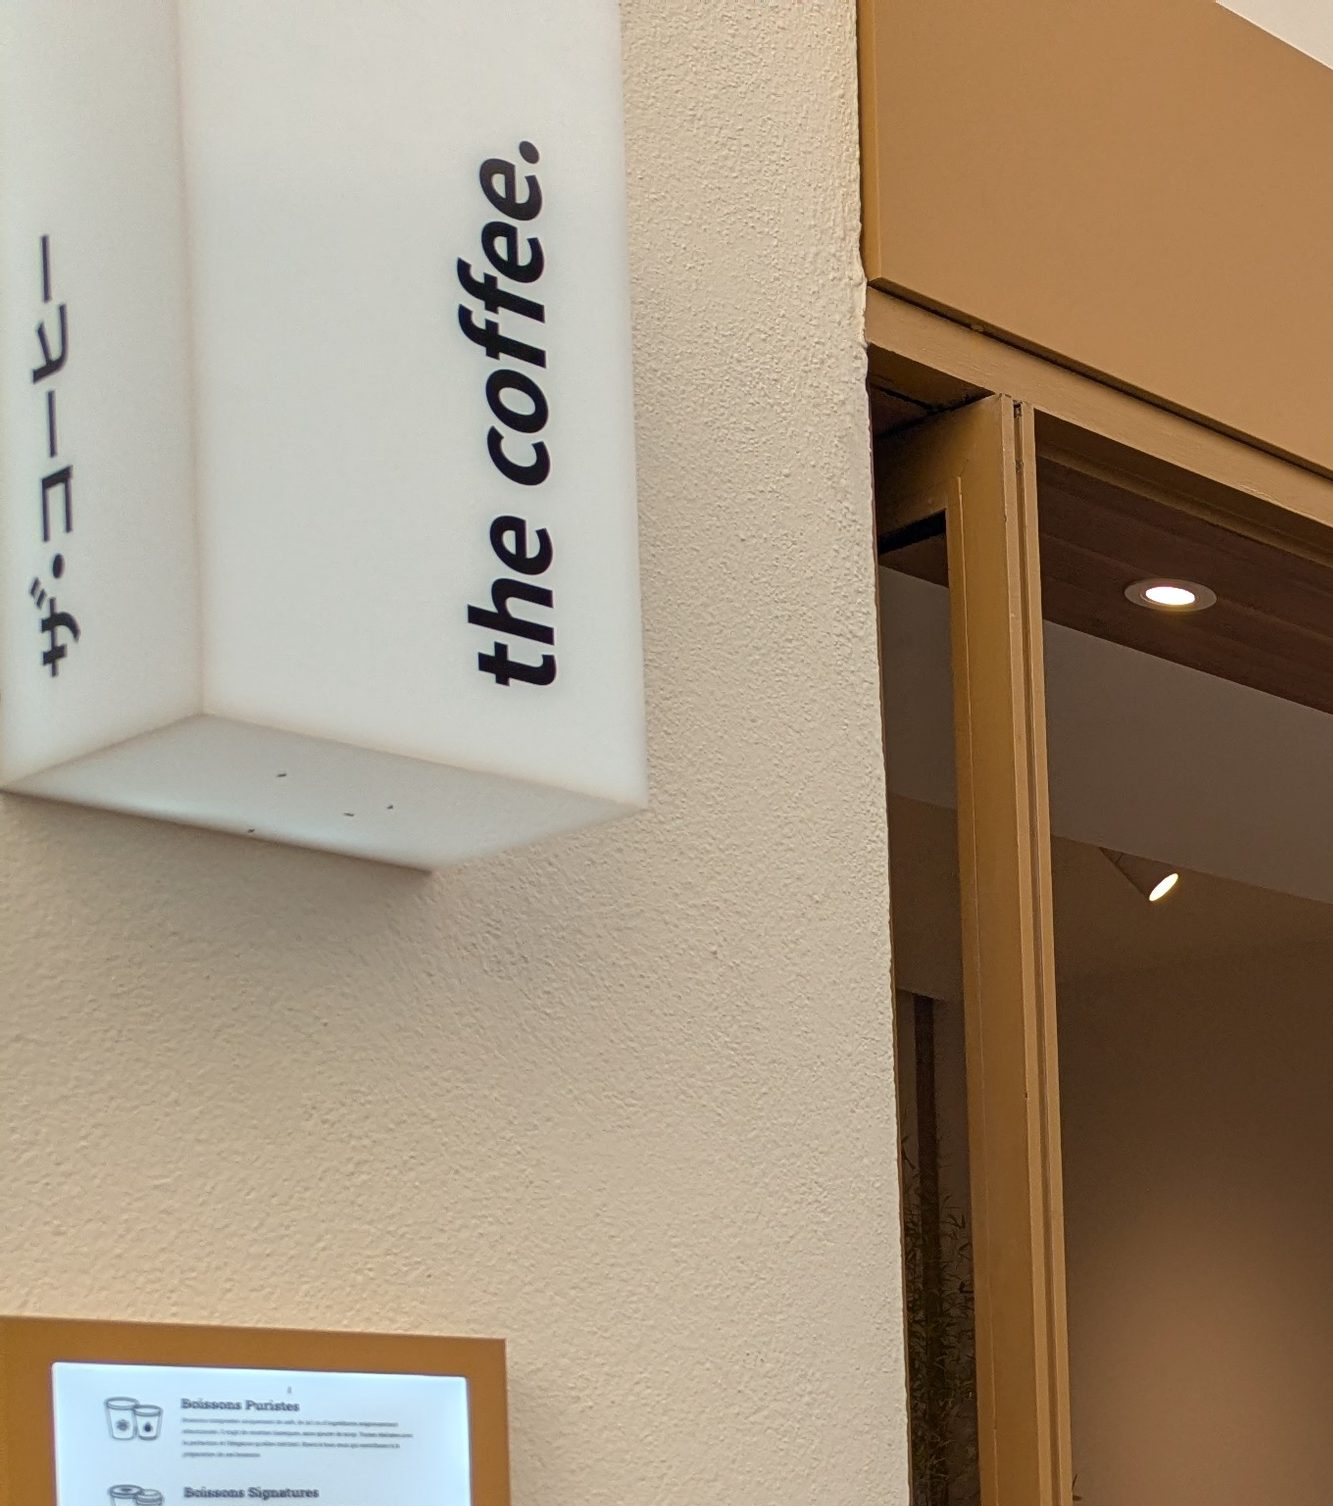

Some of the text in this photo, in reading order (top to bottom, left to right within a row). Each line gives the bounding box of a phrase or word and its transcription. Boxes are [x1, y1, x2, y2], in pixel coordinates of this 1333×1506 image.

[29, 234, 81, 679] ザ・コーヒー
[457, 140, 557, 687] the coffee.
